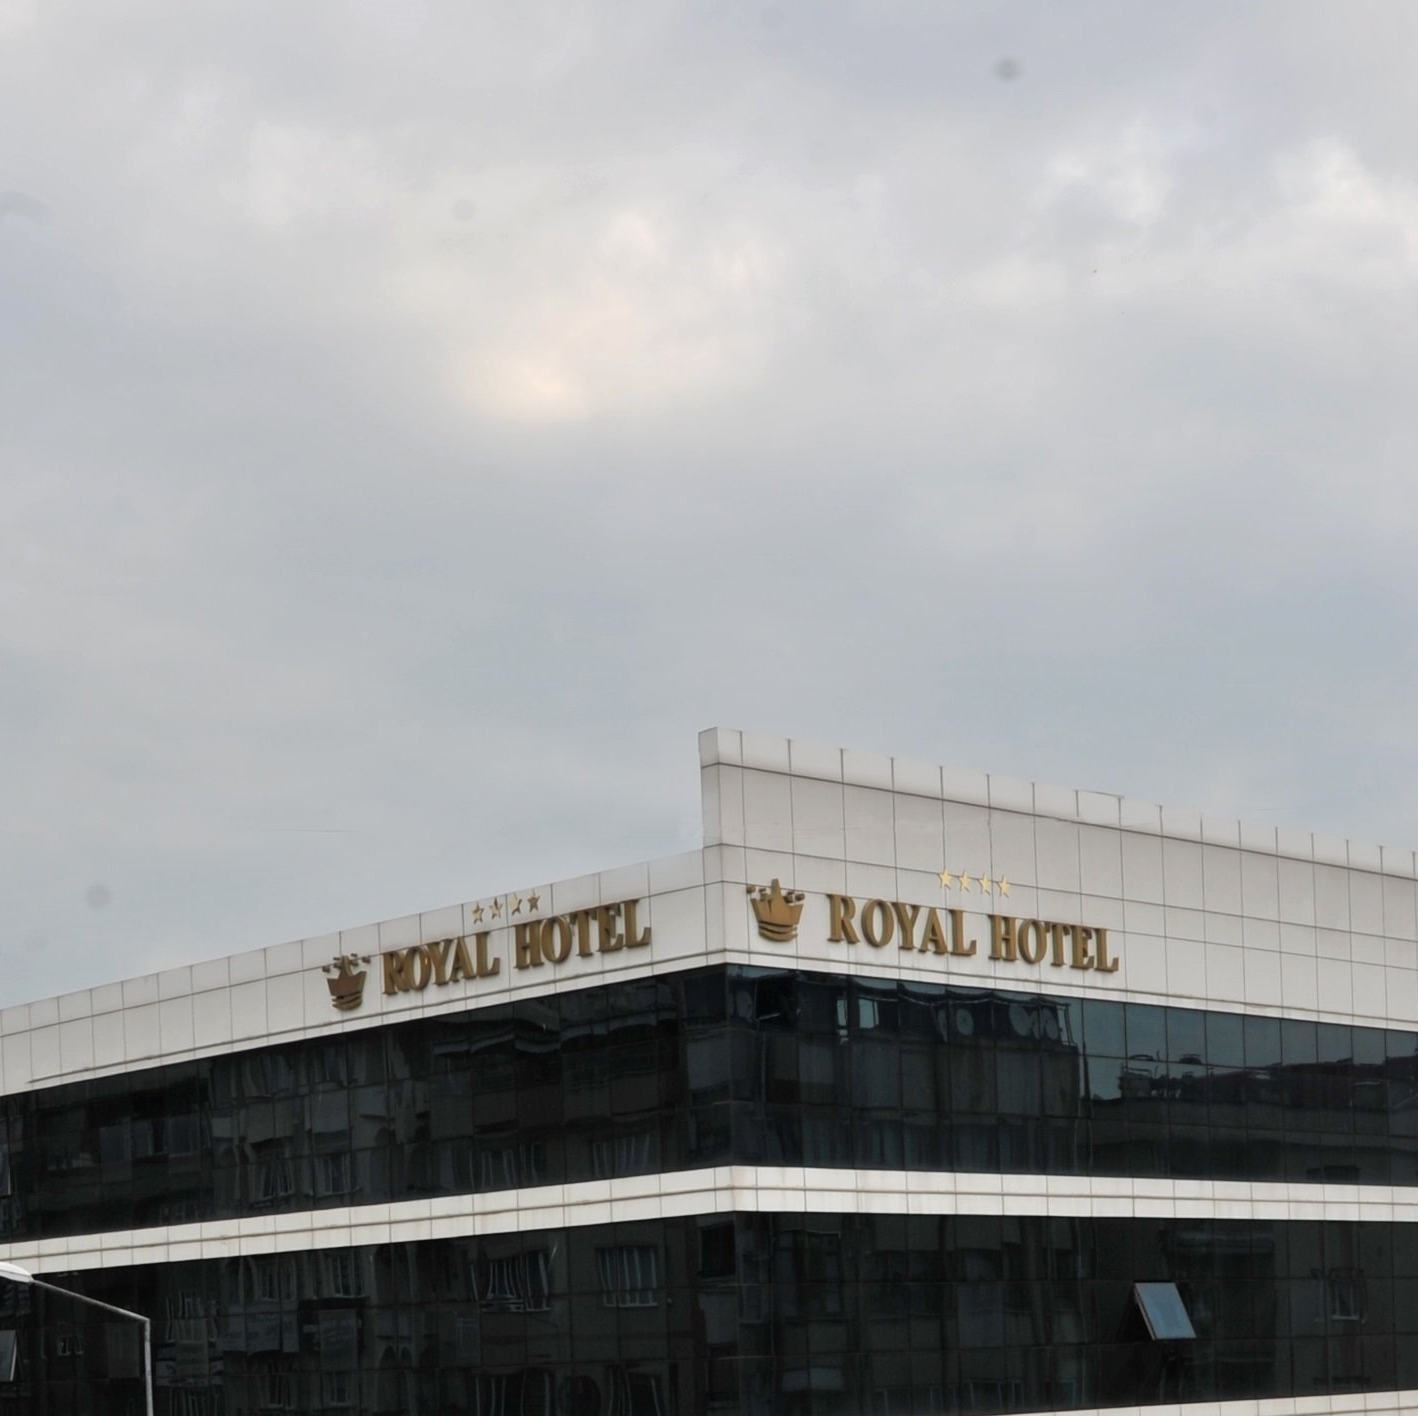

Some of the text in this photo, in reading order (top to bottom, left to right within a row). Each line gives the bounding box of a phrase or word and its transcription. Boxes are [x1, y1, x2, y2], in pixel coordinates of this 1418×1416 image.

[382, 899, 652, 995] ROYAL HOTEL
[826, 893, 1119, 973] ROYAL HOTEL
